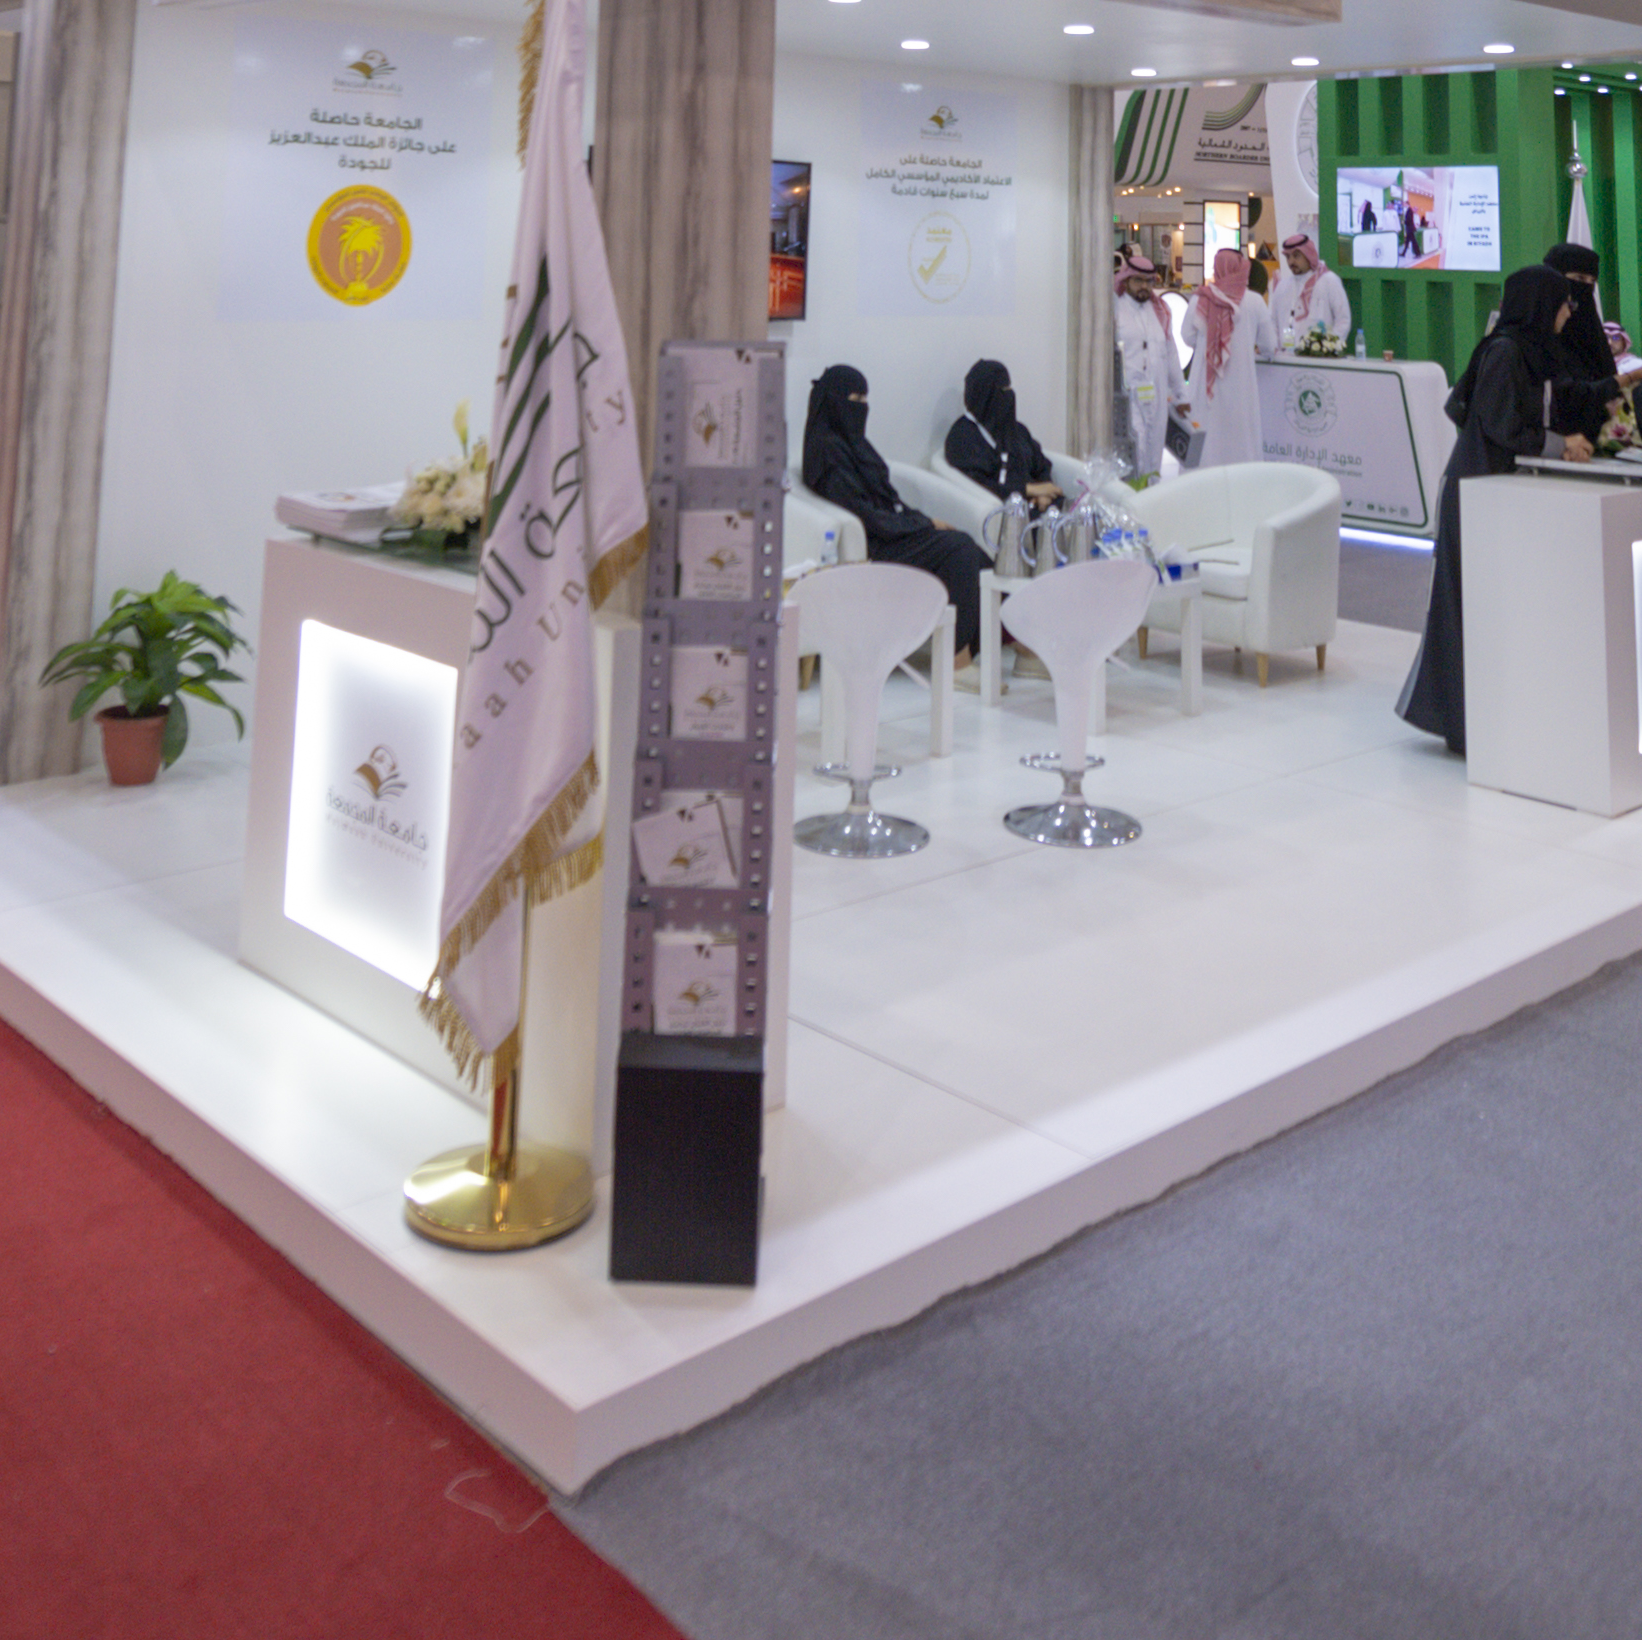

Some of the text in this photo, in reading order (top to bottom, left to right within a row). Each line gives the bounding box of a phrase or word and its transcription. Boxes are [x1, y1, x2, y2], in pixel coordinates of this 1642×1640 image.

[310, 108, 423, 131] الجامعة حاصلة
[268, 129, 457, 155] على جائزة الملك عبدالعزيز
[338, 155, 392, 172] للجودة
[899, 154, 917, 166] على
[948, 156, 983, 169] الجامعة
[1331, 452, 1363, 466] معهد
